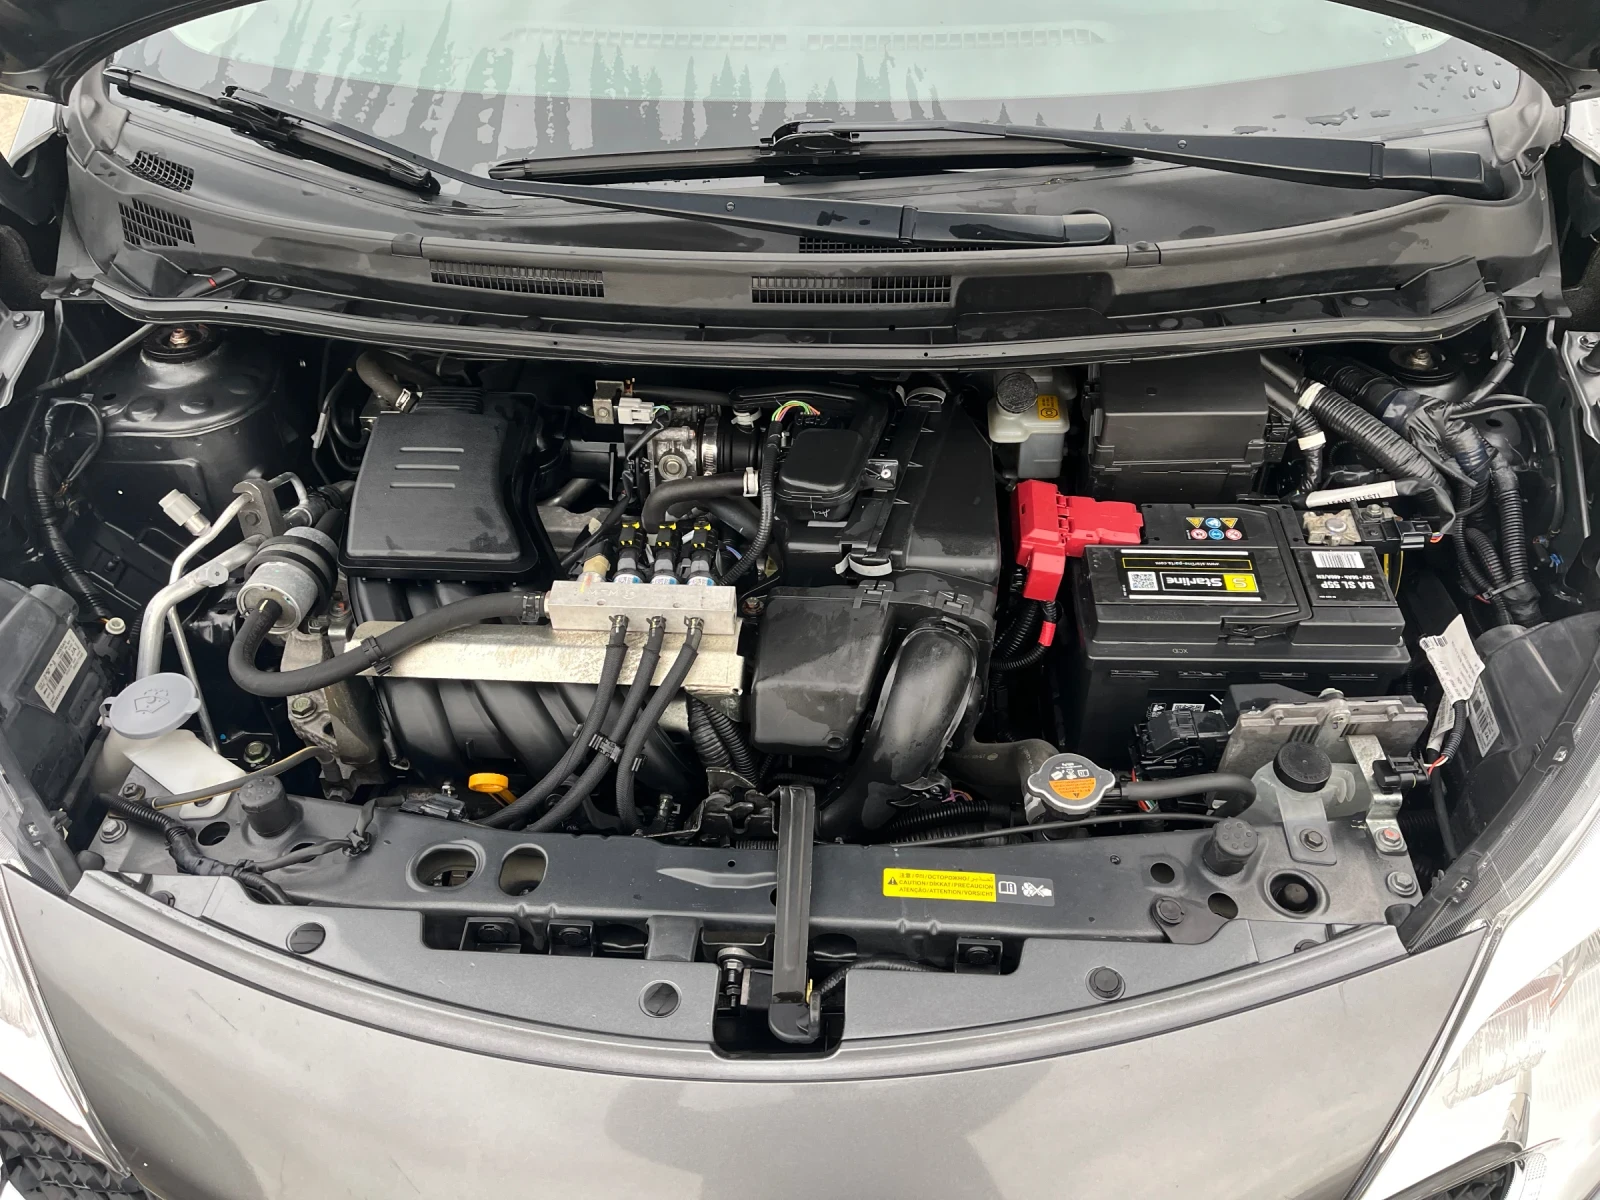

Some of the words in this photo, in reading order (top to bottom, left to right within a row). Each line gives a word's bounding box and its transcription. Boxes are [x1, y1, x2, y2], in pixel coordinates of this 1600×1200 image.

[1166, 576, 1223, 587] Starline
[1320, 580, 1341, 589] 55P
[1341, 581, 1357, 589] SL
[1357, 581, 1376, 589] BA
